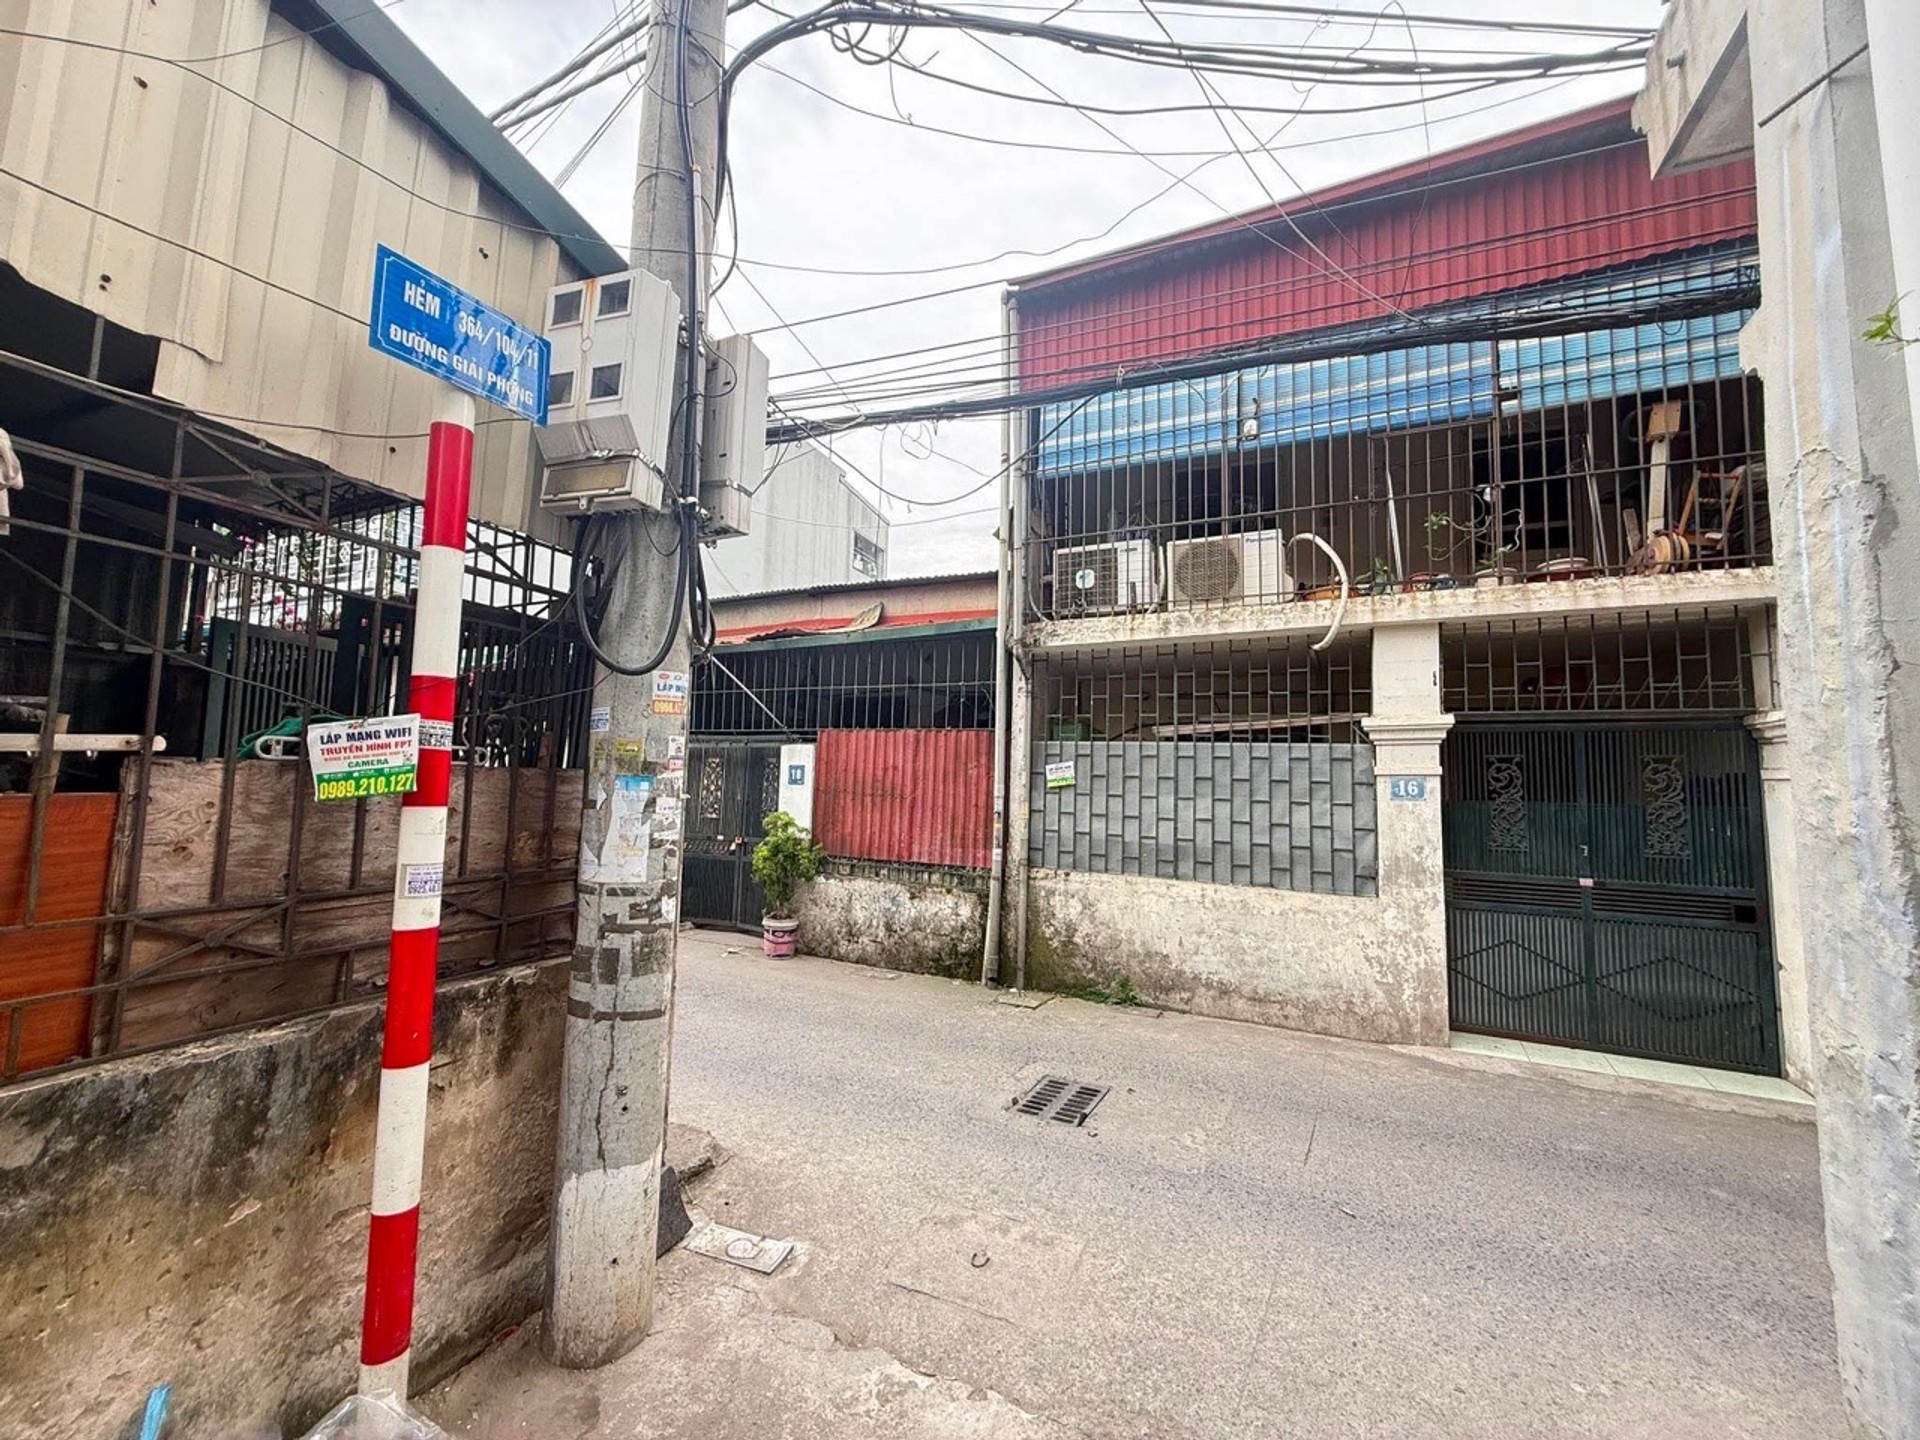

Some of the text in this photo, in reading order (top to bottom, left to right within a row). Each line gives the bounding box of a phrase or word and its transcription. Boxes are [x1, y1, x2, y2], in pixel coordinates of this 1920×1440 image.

[404, 279, 540, 370] HẺM 364/104/11
[389, 323, 448, 366] ĐƯỜNG
[453, 355, 483, 380] GIẢI
[346, 729, 381, 745] MẠNG
[385, 726, 412, 740] WIFI
[395, 739, 412, 749] FPT
[347, 757, 390, 769] CAMERA
[320, 772, 414, 800] 0989.210.127
[1397, 780, 1419, 796] 16
